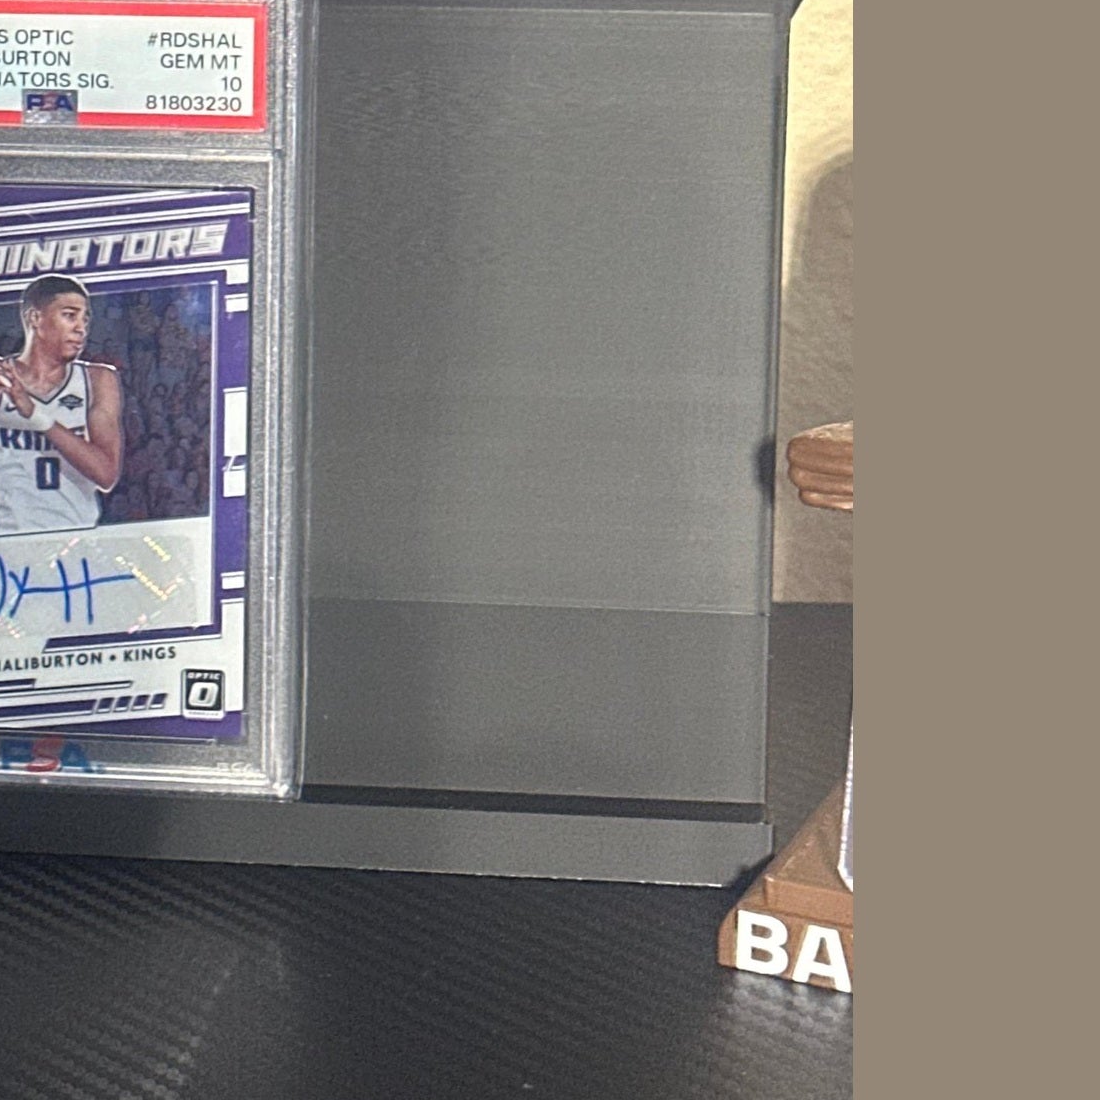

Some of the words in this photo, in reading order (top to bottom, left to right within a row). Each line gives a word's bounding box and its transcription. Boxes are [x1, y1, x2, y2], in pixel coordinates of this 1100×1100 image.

[14, 29, 74, 45] OPTIC
[147, 31, 242, 49] #RDSHAL
[160, 53, 205, 69] GEM
[211, 54, 242, 70] MT
[77, 73, 115, 89] SIG.
[221, 76, 243, 92] 10
[26, 92, 74, 112] PSA
[145, 95, 242, 112] 81803230
[35, 456, 60, 490] 0
[123, 646, 177, 663] KINGS
[187, 671, 221, 681] OPTIC
[1, 735, 94, 773] PSA
